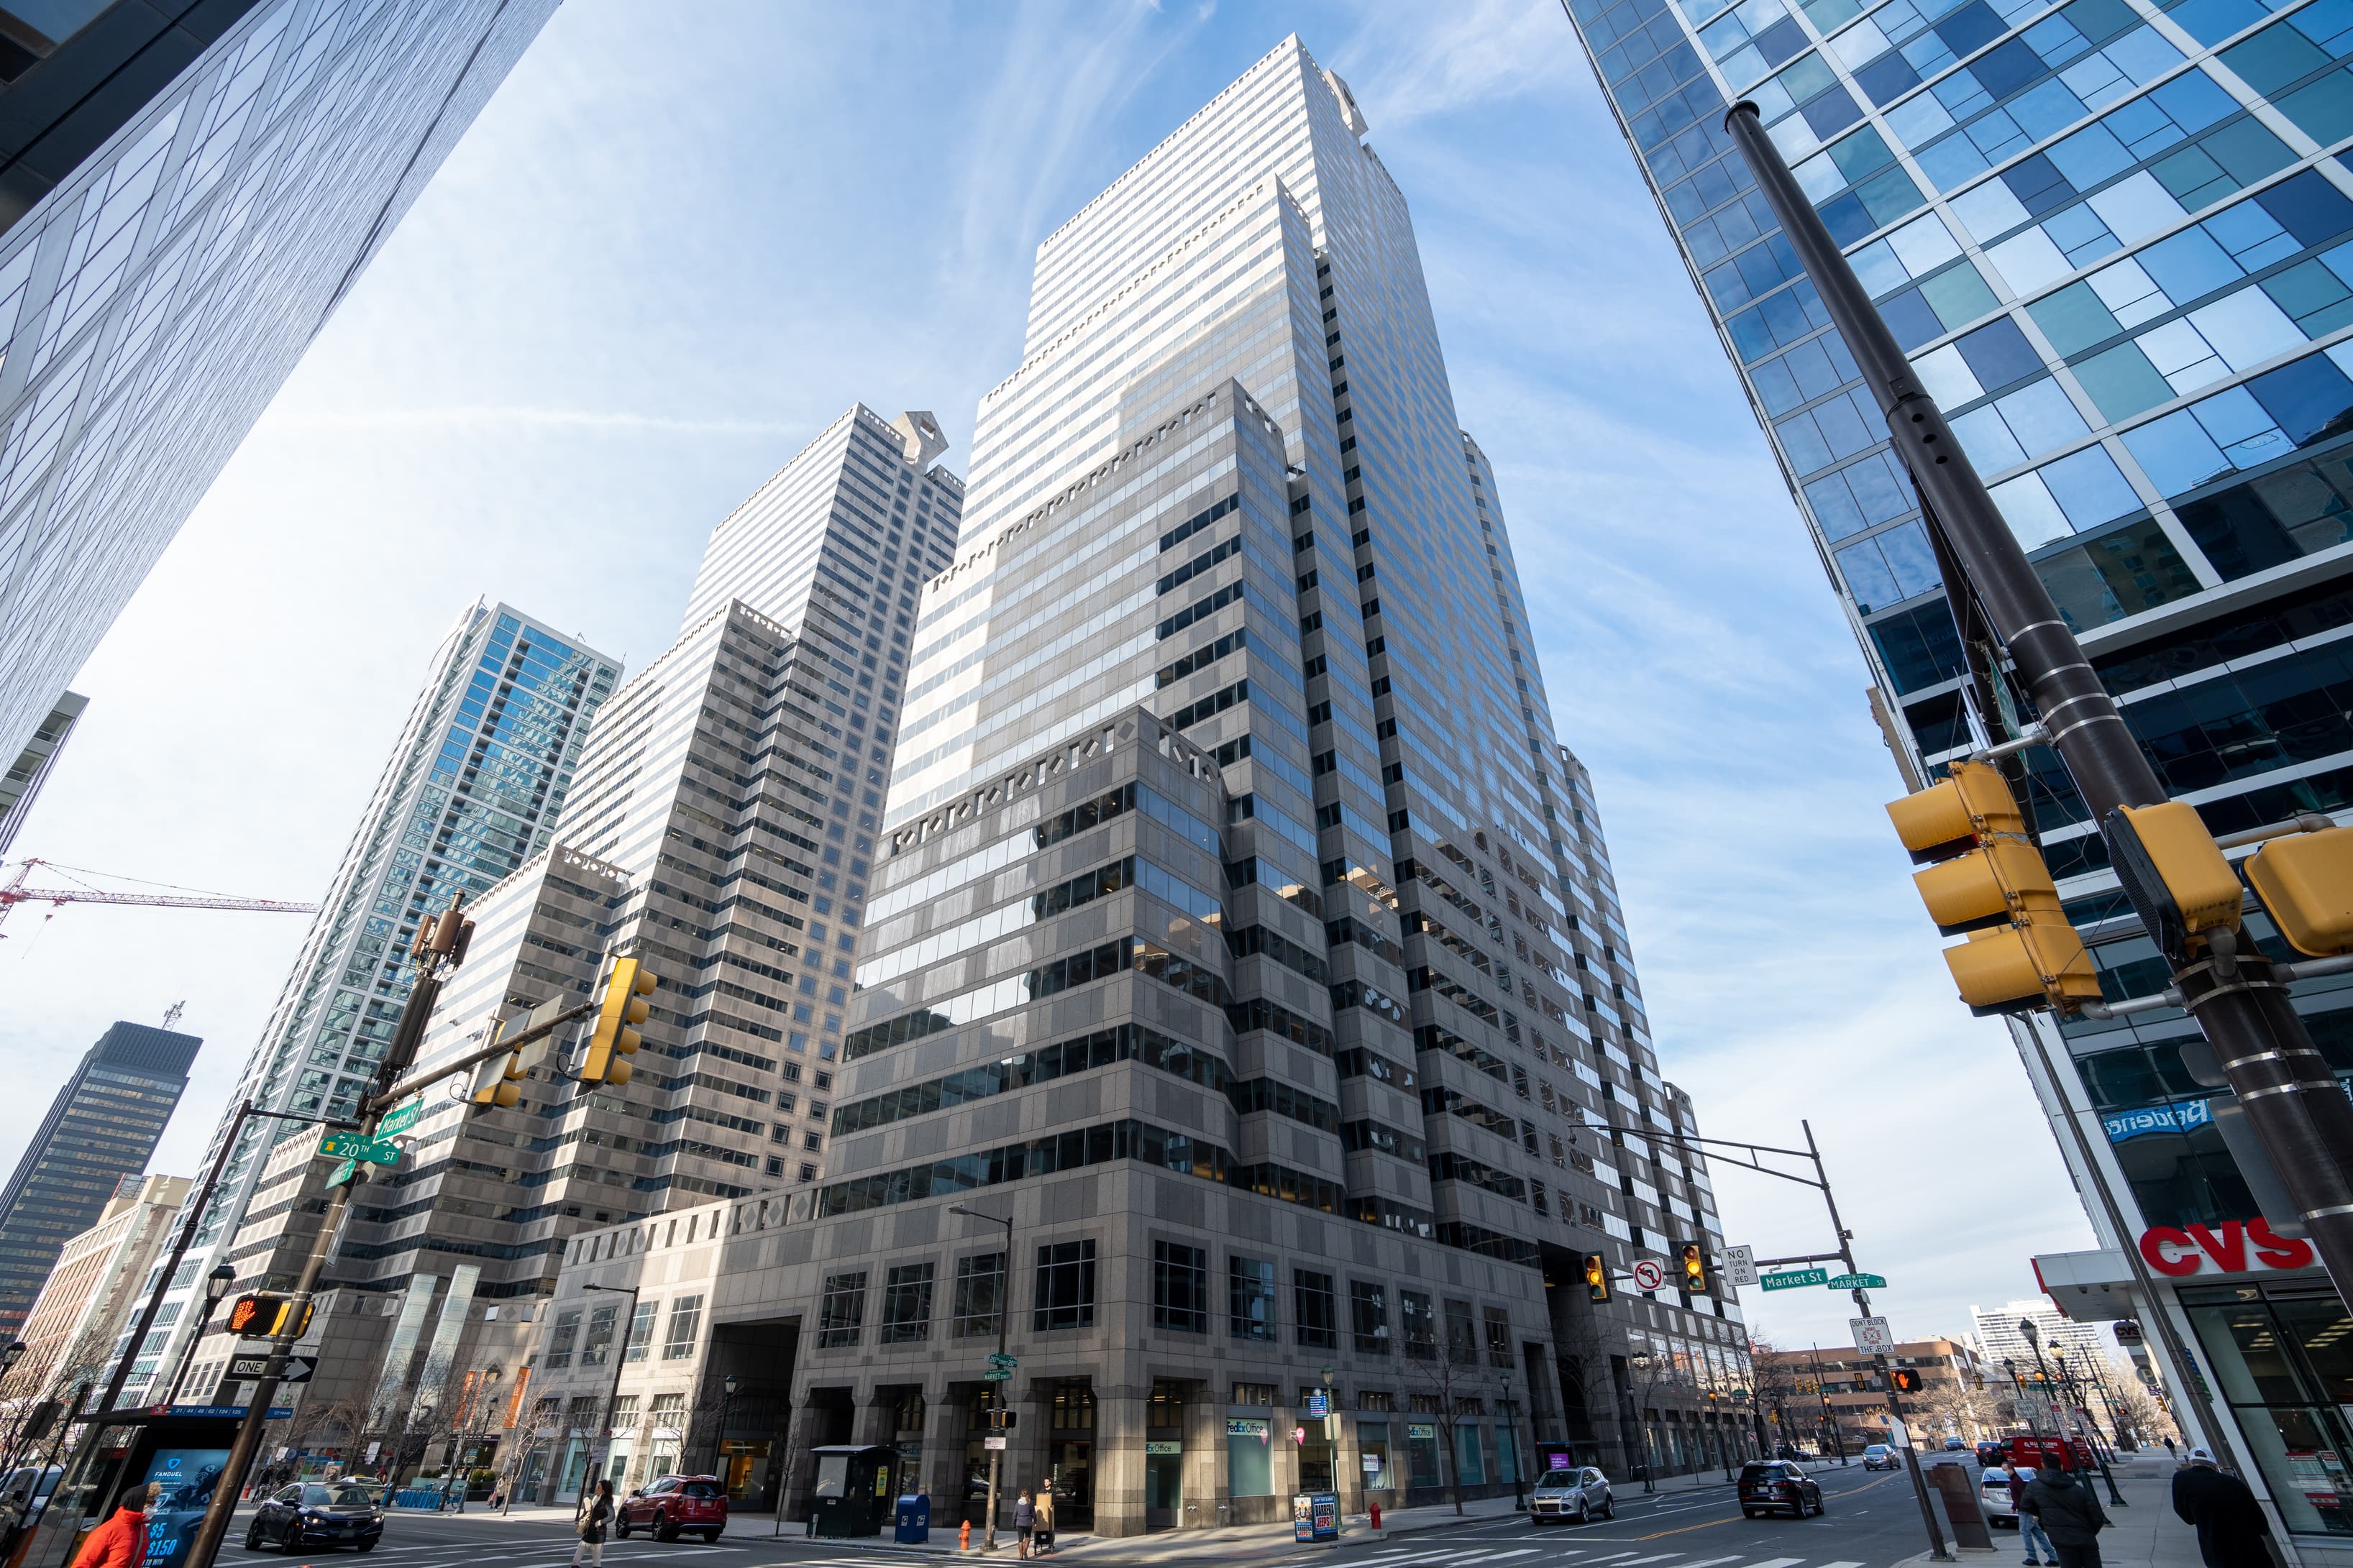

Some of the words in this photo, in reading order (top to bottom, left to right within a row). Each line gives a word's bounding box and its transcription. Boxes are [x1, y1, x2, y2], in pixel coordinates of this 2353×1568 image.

[380, 1114, 408, 1135] Market
[408, 1105, 419, 1123] St
[383, 1152, 396, 1161] ST
[2139, 1216, 2313, 1276] CVS
[1727, 1250, 1744, 1259] NO
[1765, 1275, 1806, 1288] Market
[1809, 1272, 1822, 1283] St
[1831, 1278, 1869, 1288] MARKET
[2115, 1326, 2140, 1336] CVS
[237, 1362, 262, 1372] ONE
[2143, 1369, 2154, 1383] P
[1246, 1423, 1264, 1434] Office
[1154, 1444, 1171, 1452] Office
[1315, 1503, 1335, 1517] BARBERA
[1317, 1516, 1330, 1527] JEEPS
[150, 1522, 168, 1538] $5
[147, 1539, 178, 1556] $150
